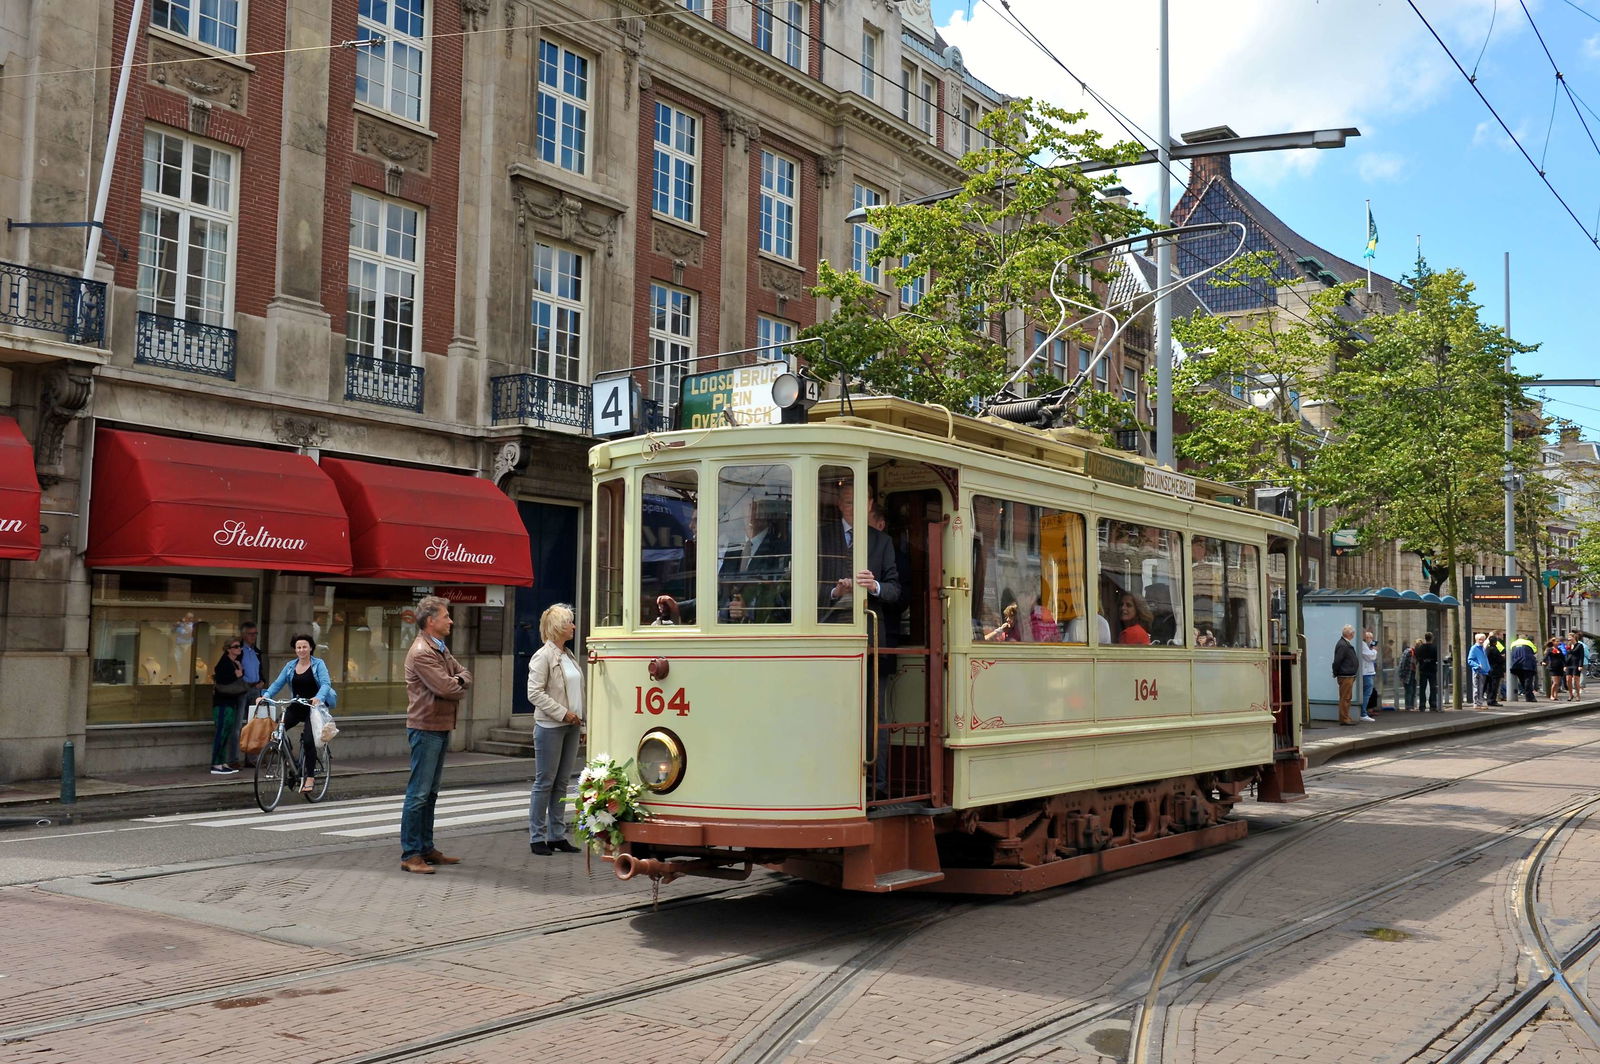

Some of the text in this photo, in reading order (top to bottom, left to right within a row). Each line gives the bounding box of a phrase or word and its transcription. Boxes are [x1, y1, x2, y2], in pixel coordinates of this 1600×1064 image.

[712, 390, 752, 410] PLEIN
[808, 382, 816, 398] 4
[601, 386, 622, 426] 4
[213, 519, 308, 550] Steltman
[424, 537, 497, 565] Steltman
[442, 587, 478, 601] Steltman
[634, 686, 690, 717] 164
[1134, 678, 1158, 701] 164
